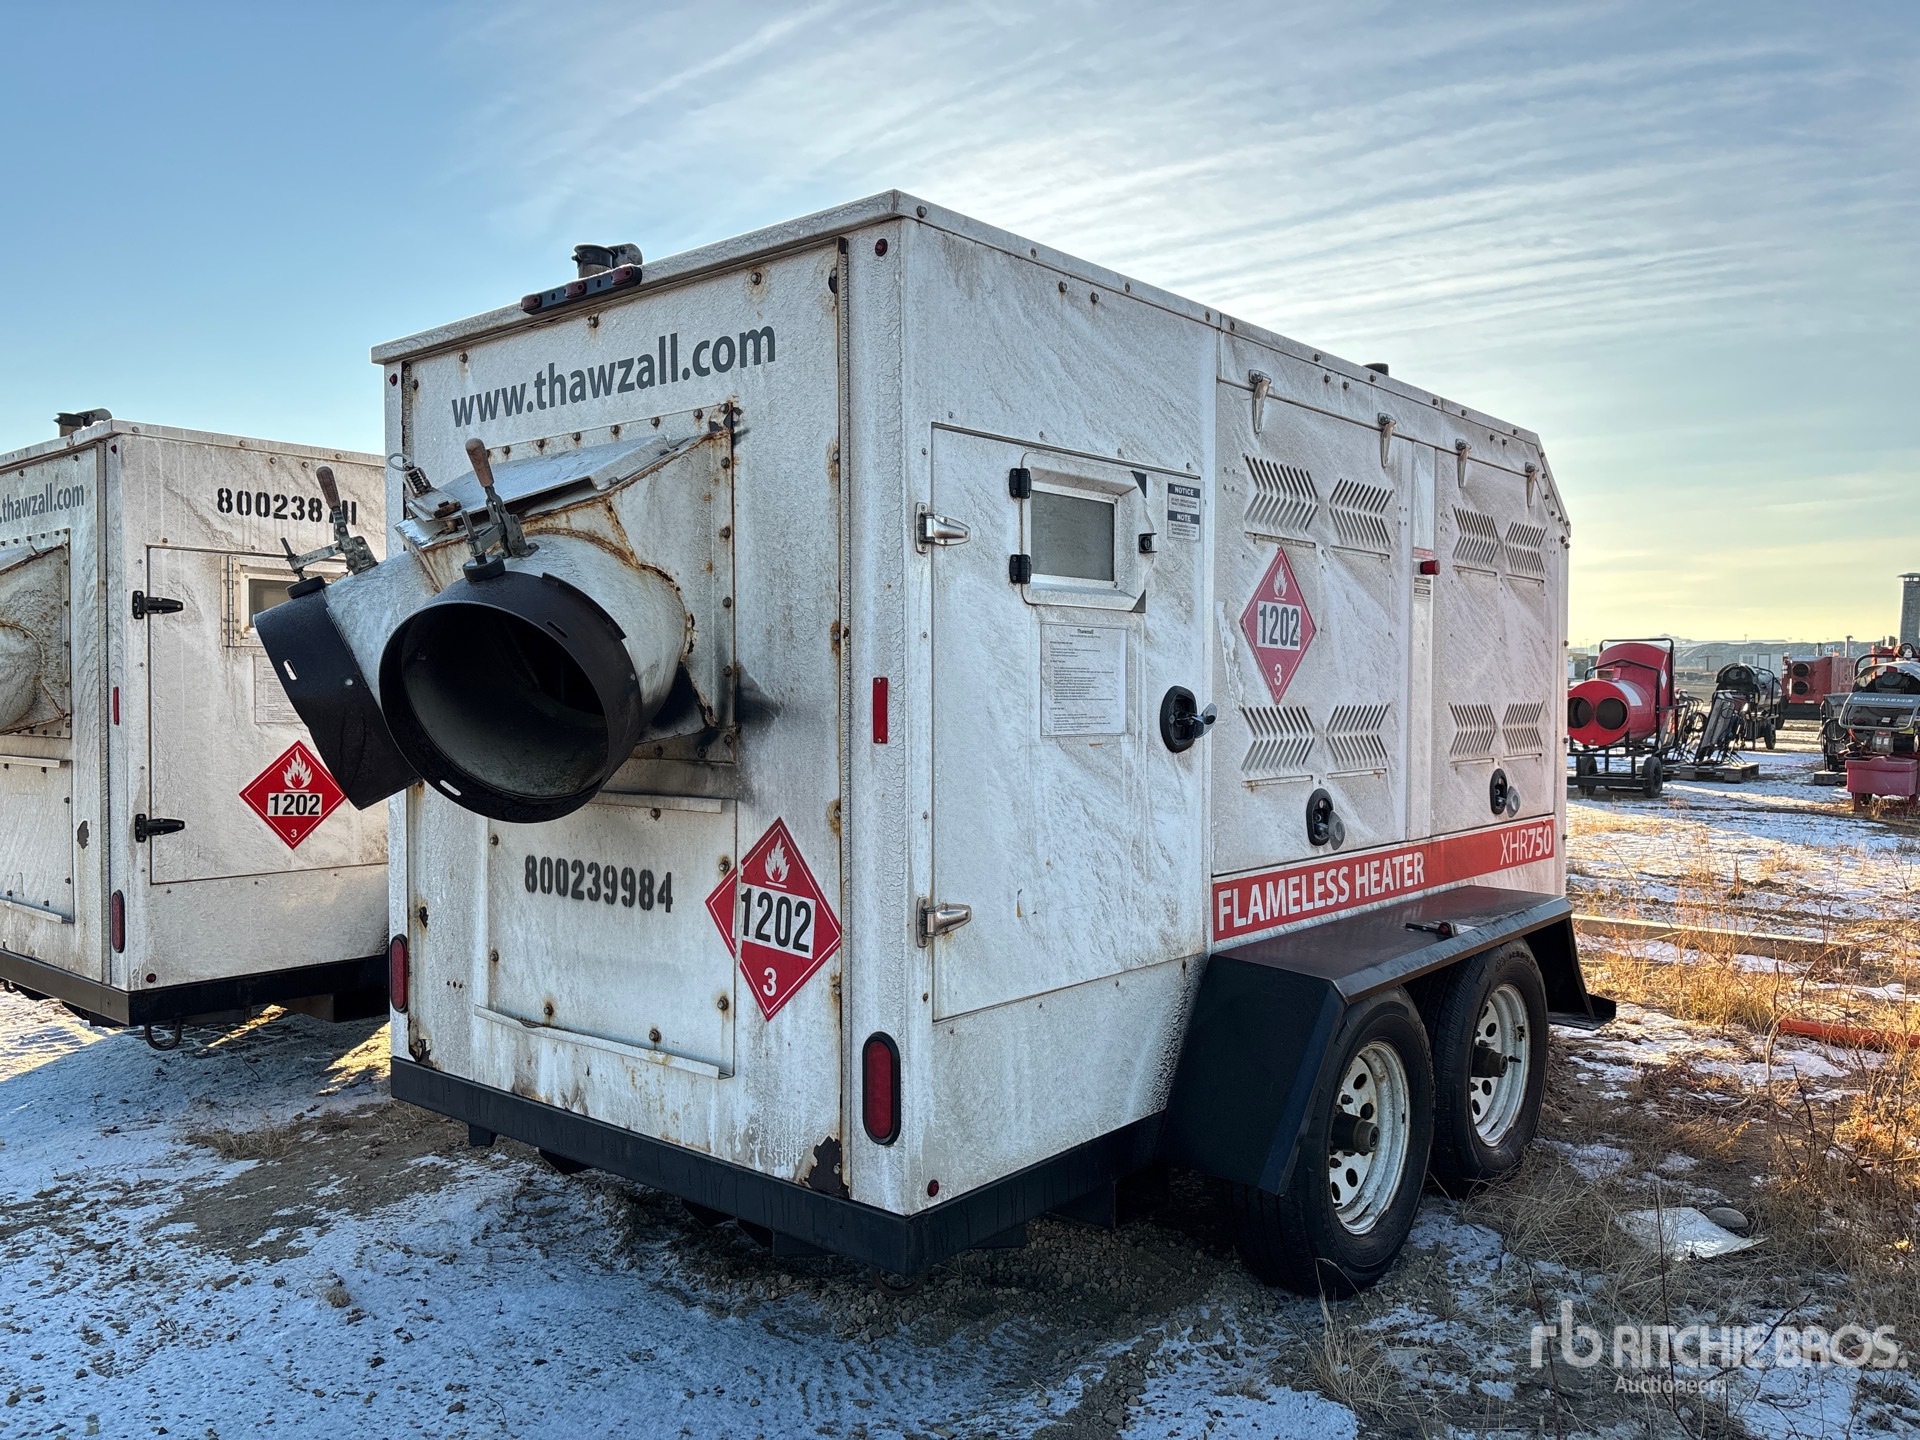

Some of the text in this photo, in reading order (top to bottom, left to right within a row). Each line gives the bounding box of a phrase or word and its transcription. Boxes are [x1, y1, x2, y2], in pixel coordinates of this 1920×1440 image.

[452, 325, 776, 428] www.thawzall.com
[217, 487, 357, 526] 80023811
[1174, 485, 1195, 497] NOTICE
[1176, 513, 1192, 523] NOTE
[1258, 603, 1300, 647] 1202
[1273, 663, 1283, 686] 3
[269, 793, 321, 816] 1202
[290, 828, 298, 838] 3
[1499, 825, 1552, 866] XHR750
[524, 854, 673, 913] 800239984
[1217, 851, 1425, 932] FLAMELESS HEATER
[740, 887, 812, 954] 1202
[762, 966, 778, 997] 3
